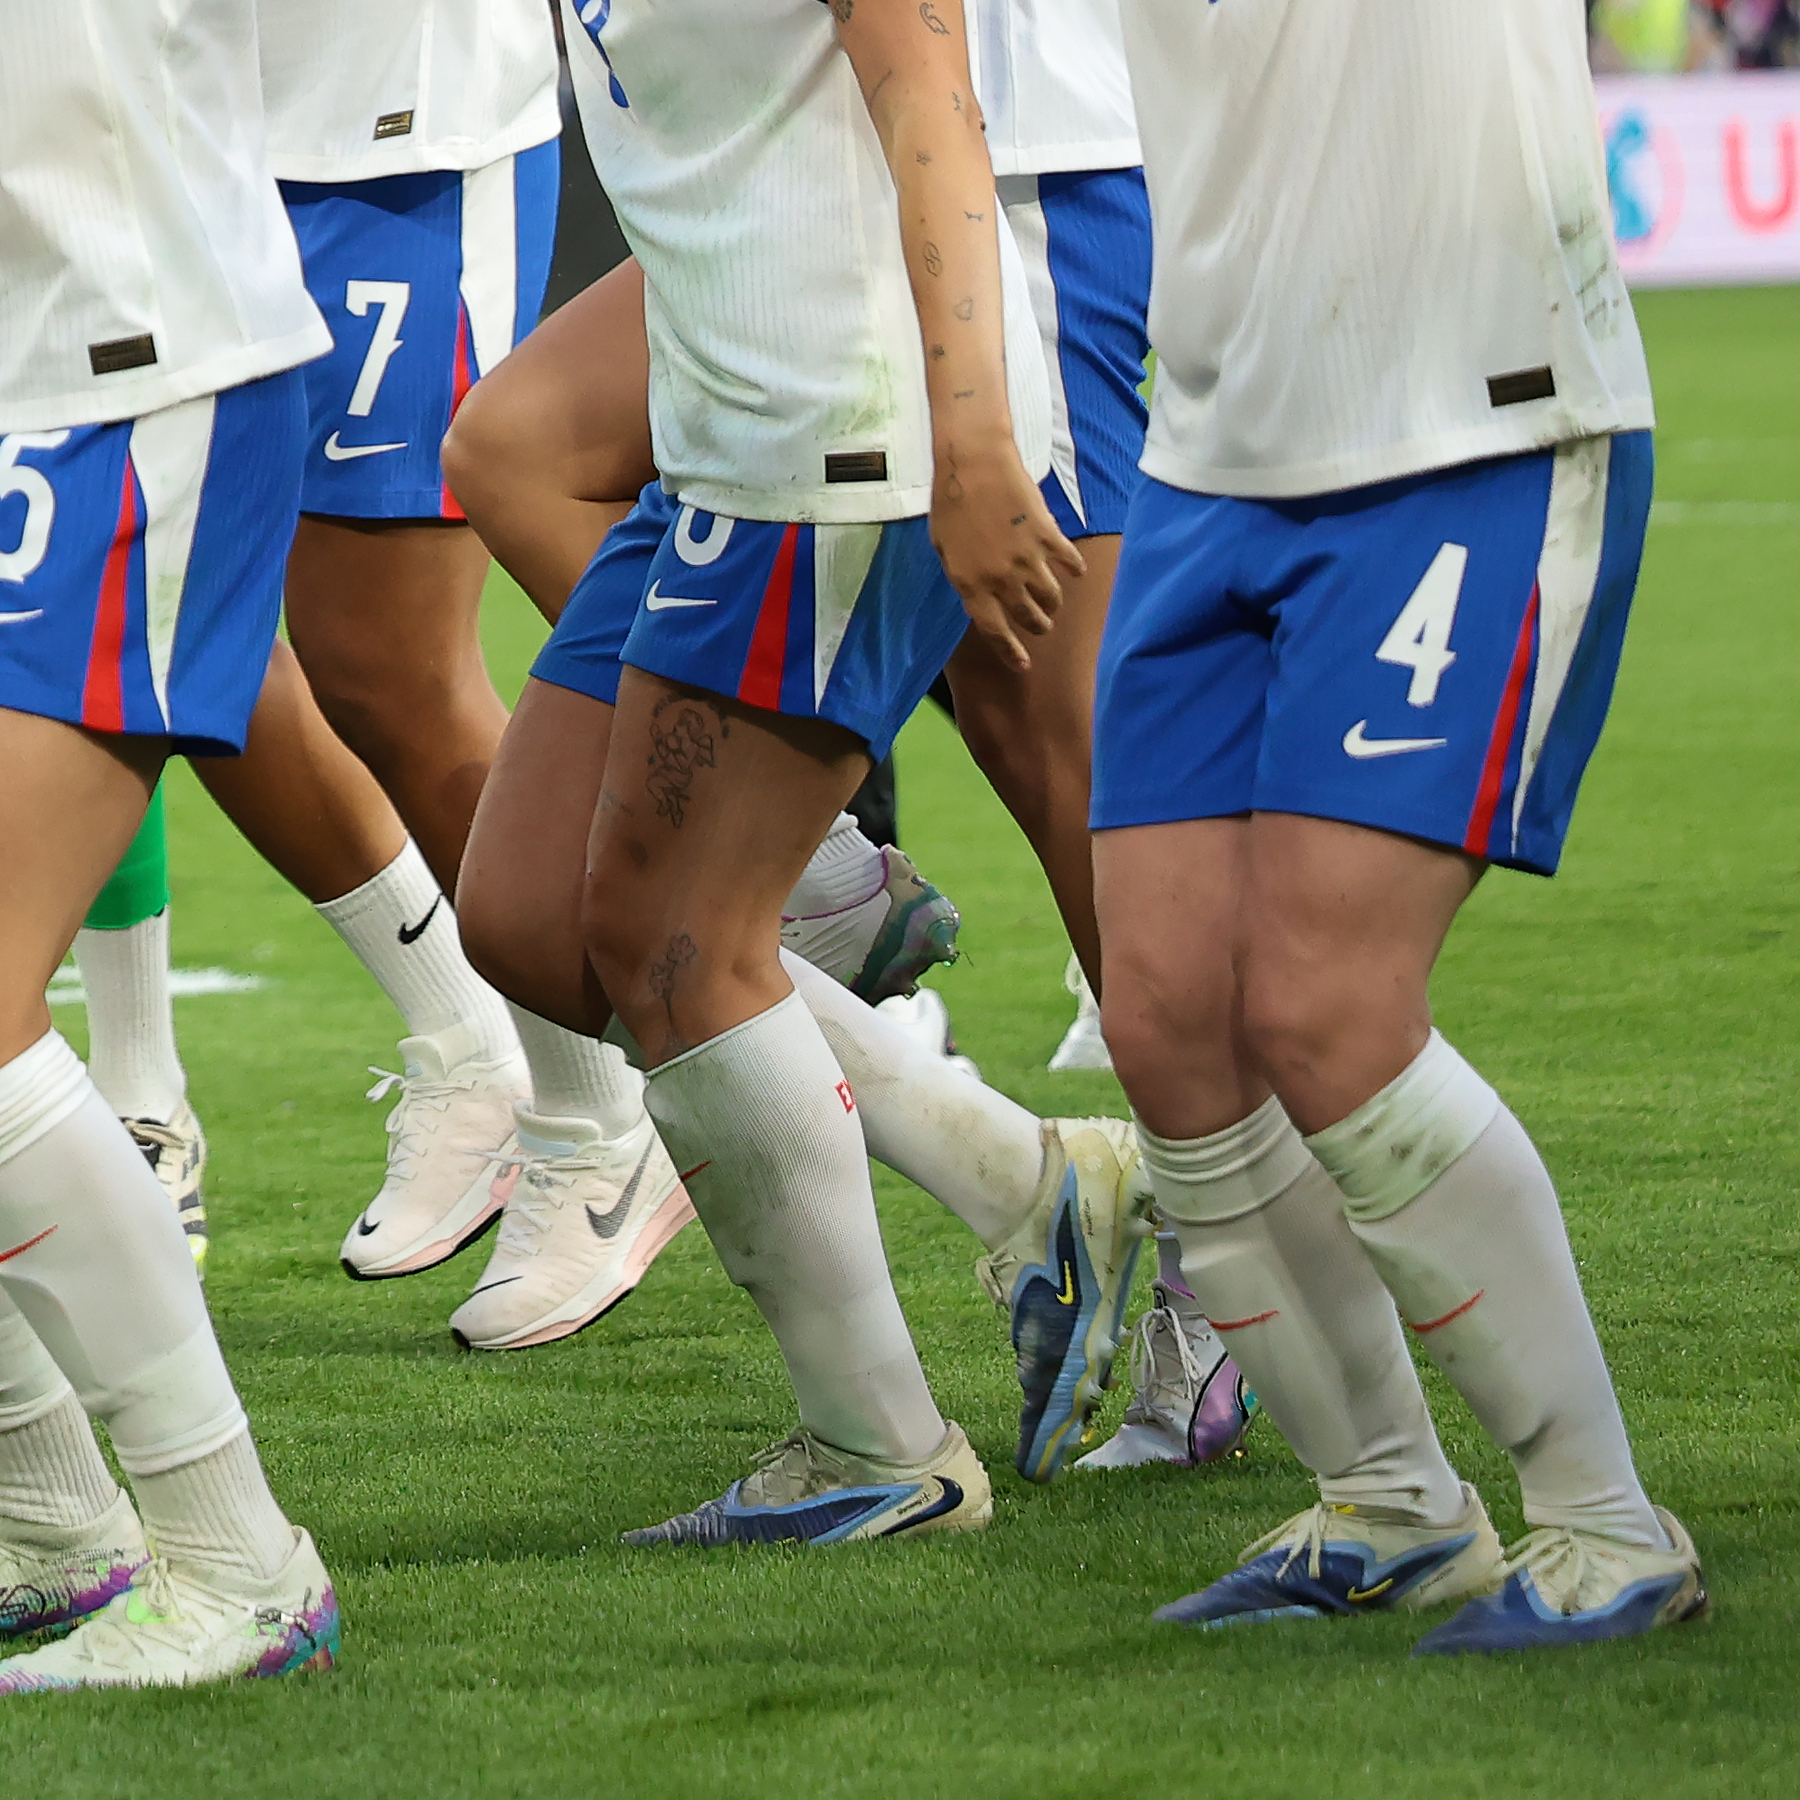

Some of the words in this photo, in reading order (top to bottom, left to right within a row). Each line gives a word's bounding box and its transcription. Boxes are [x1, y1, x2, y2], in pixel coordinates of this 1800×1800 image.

[1722, 114, 1800, 234] U
[345, 279, 411, 417] 7
[1375, 540, 1468, 708] 4
